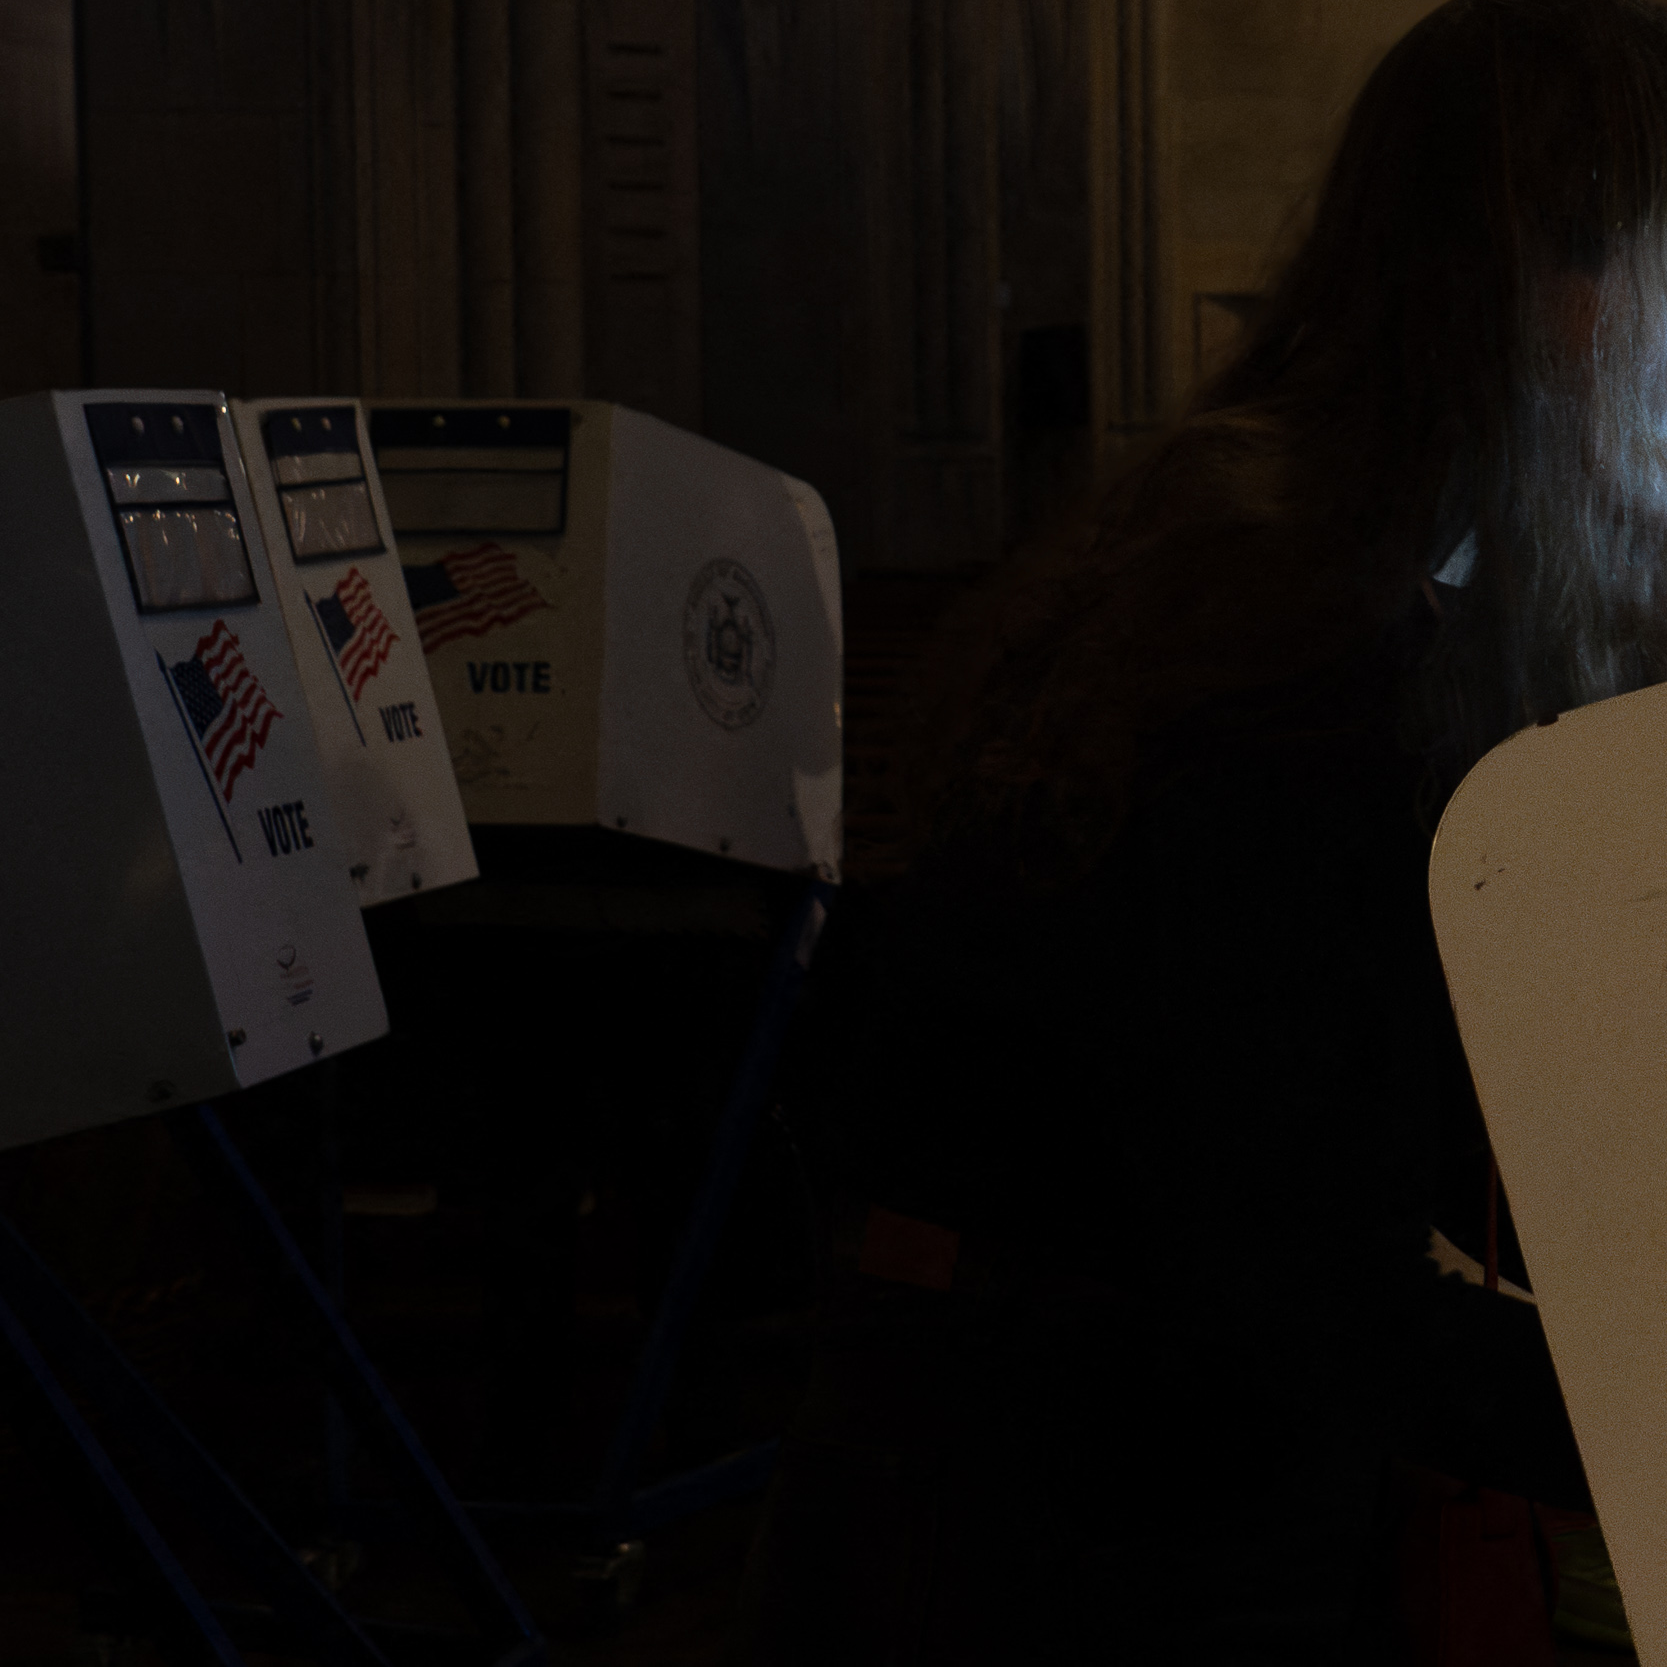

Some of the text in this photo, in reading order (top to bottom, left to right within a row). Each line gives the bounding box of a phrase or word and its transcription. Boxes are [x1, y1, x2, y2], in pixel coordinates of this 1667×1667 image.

[467, 661, 552, 694] VOTE
[378, 702, 423, 743] VOTE
[257, 800, 315, 857] VOTE
